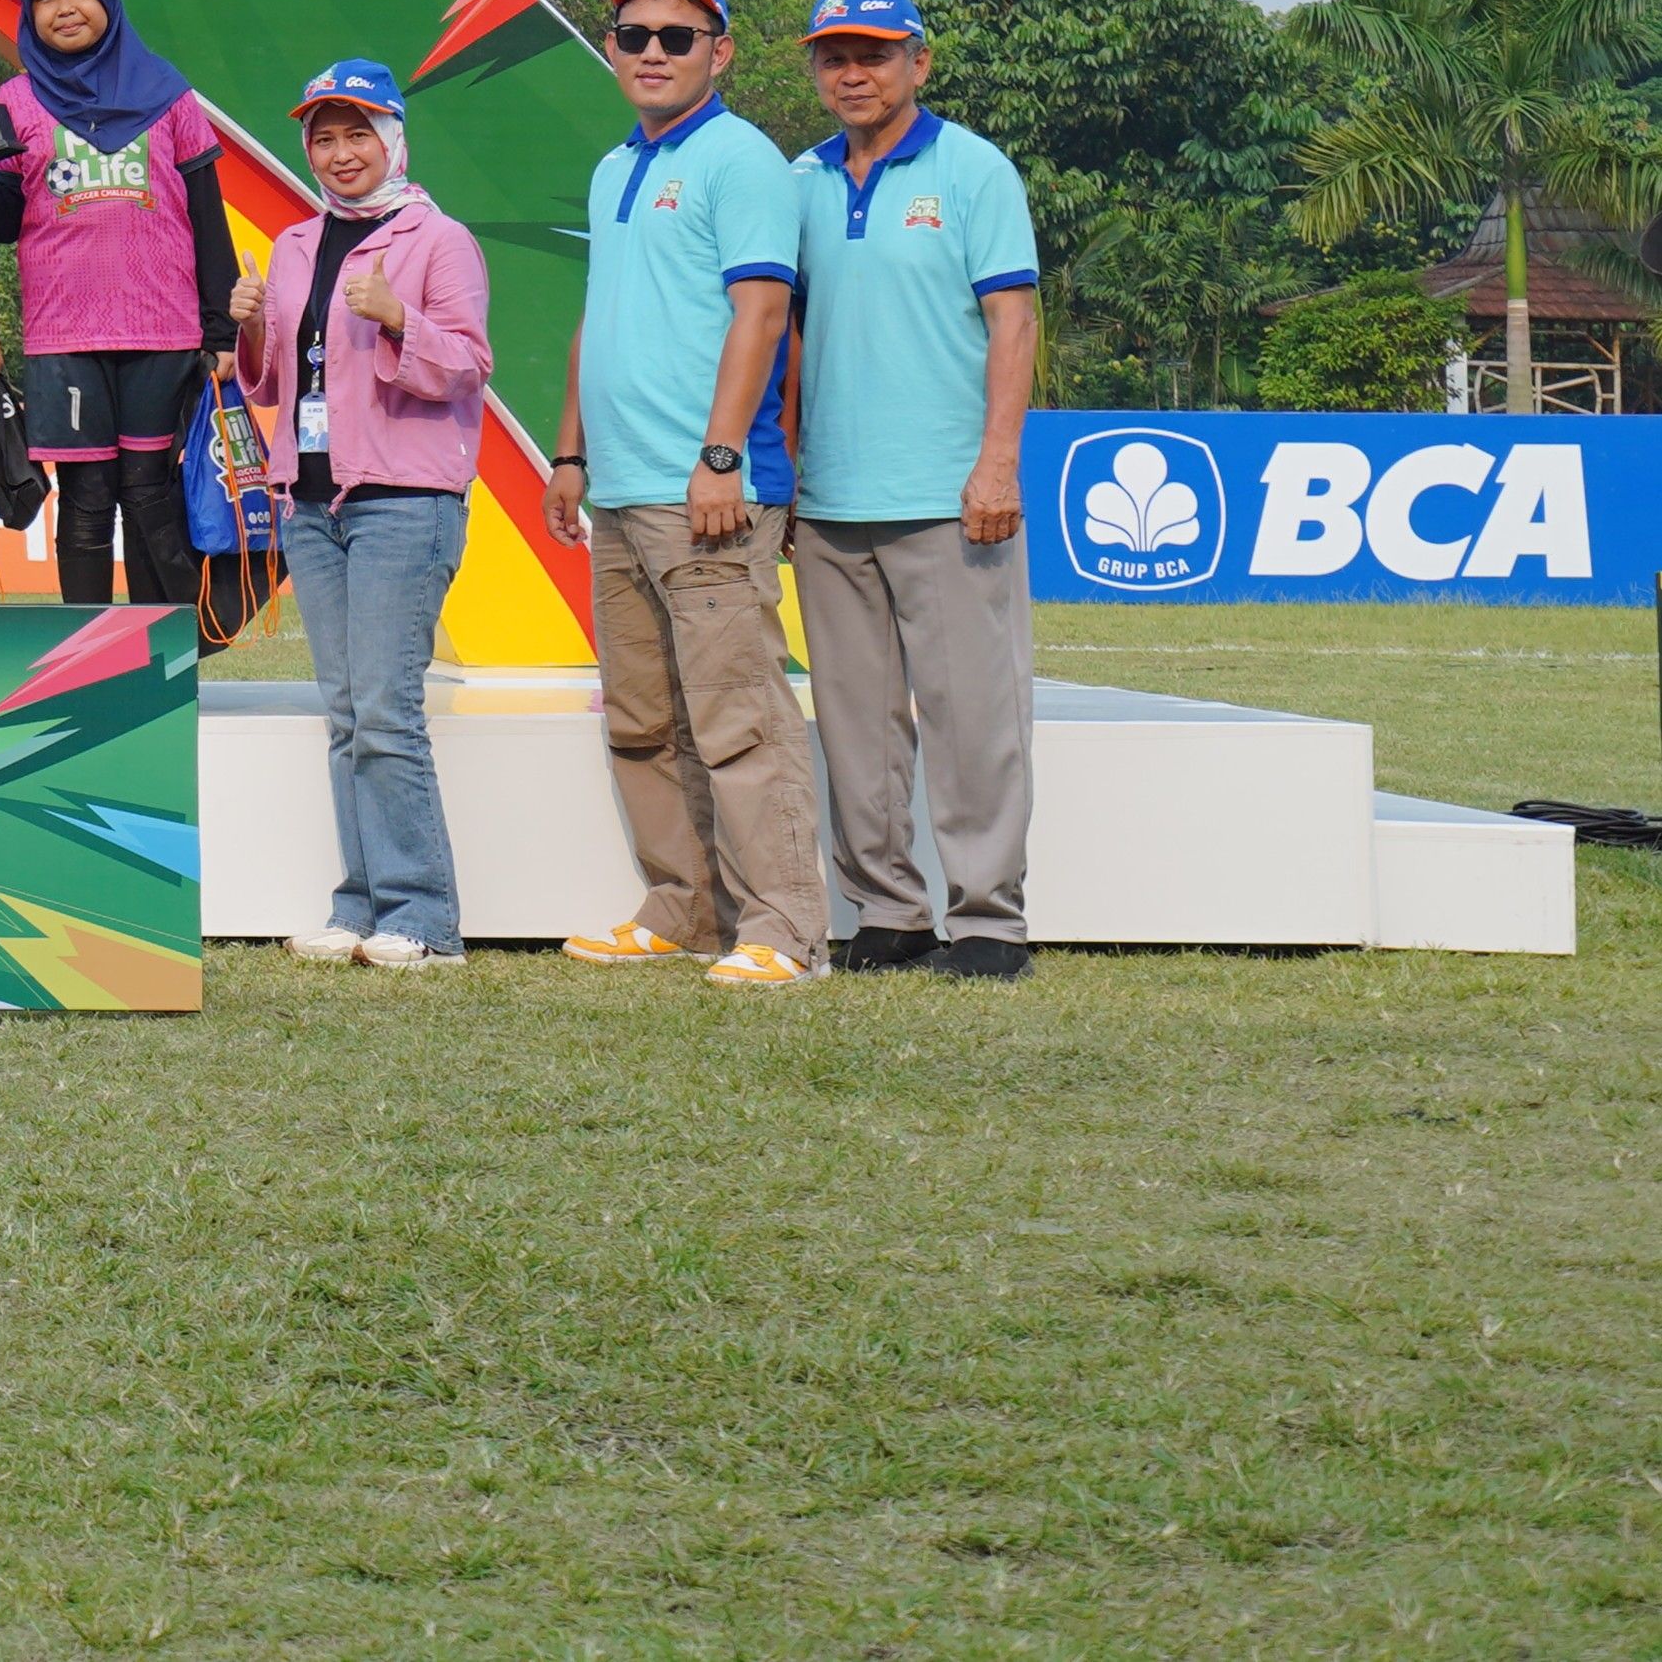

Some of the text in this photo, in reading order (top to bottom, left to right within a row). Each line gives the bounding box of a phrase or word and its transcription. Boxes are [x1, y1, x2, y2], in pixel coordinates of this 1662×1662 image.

[80, 153, 145, 188] Life
[68, 386, 81, 431] 1
[1249, 441, 1593, 582] BCA
[1097, 556, 1190, 580] GRUP BCA
